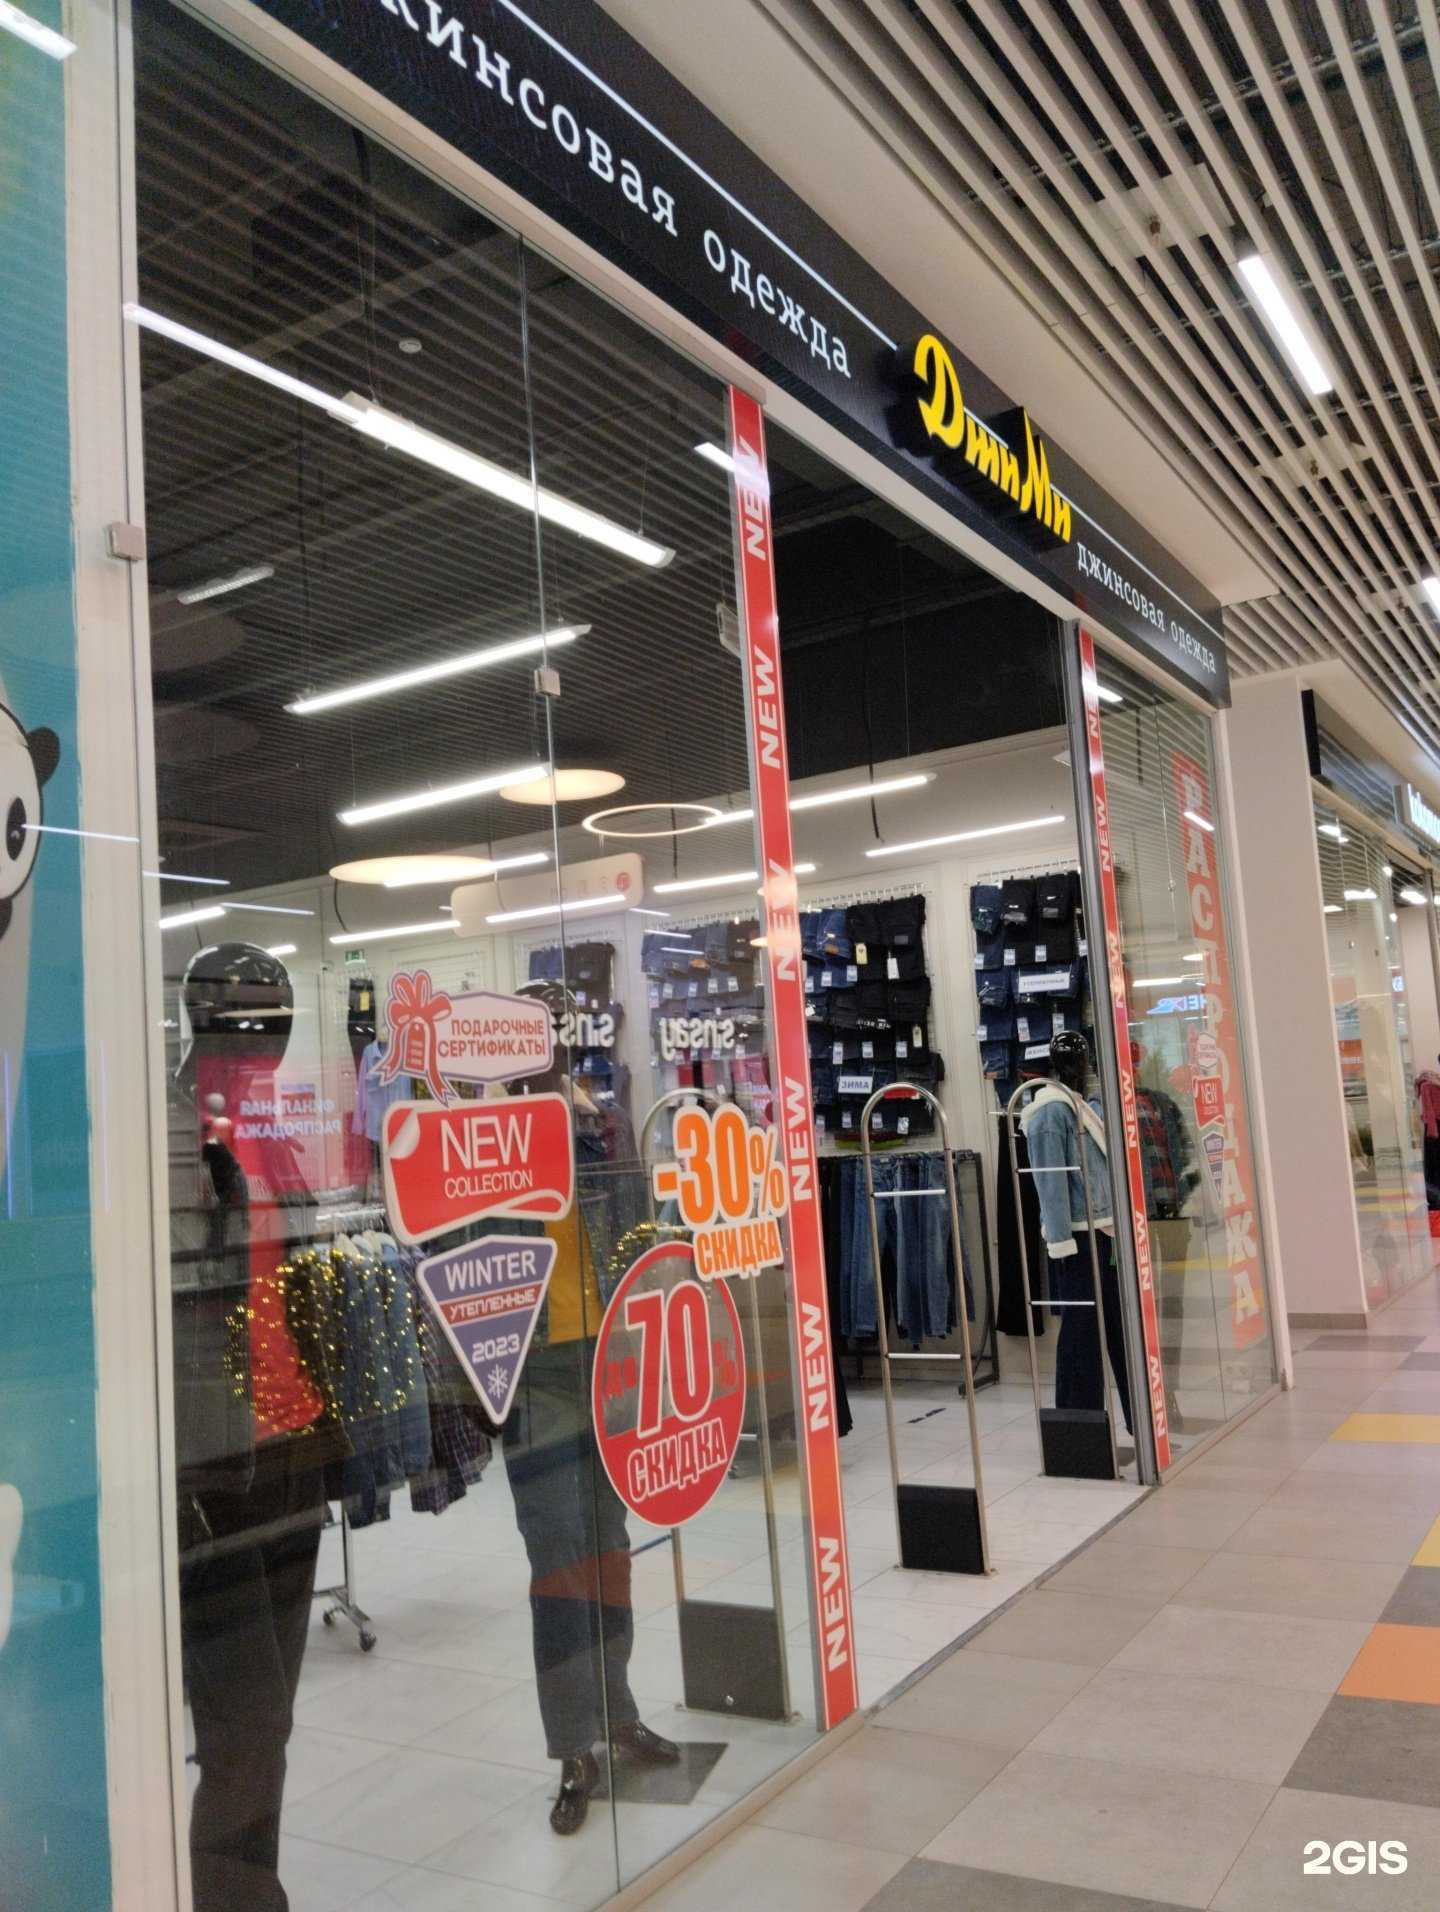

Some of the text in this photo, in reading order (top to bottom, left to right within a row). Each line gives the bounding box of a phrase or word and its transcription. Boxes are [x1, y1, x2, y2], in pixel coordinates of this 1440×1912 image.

[703, 229, 851, 378] одежда
[1077, 542, 1217, 674] джинсовая одежда
[754, 646, 782, 768] NEW
[1094, 799, 1111, 873] NEW
[1107, 931, 1125, 1008] NEW
[438, 1039, 546, 1057] СЕРТИФИКАТЫ
[451, 1019, 544, 1036] ПОДАРОЧНЫЕ
[441, 1112, 532, 1172] NEW
[783, 1077, 812, 1200] NEW
[1120, 1070, 1138, 1148] NEW
[444, 1169, 533, 1199] COLLECTION
[657, 1109, 786, 1225] -30%
[444, 1249, 536, 1292] WINTER
[699, 1221, 781, 1276] СКИДКА
[1132, 1211, 1152, 1292] NEW
[449, 1288, 535, 1321] УТЕПЛЕННЫЕ
[472, 1333, 520, 1364] 2023
[803, 1302, 831, 1433] NEW
[1149, 1355, 1167, 1438] NEW
[627, 1417, 728, 1503] СКИДКА
[820, 1536, 848, 1672] NEW
